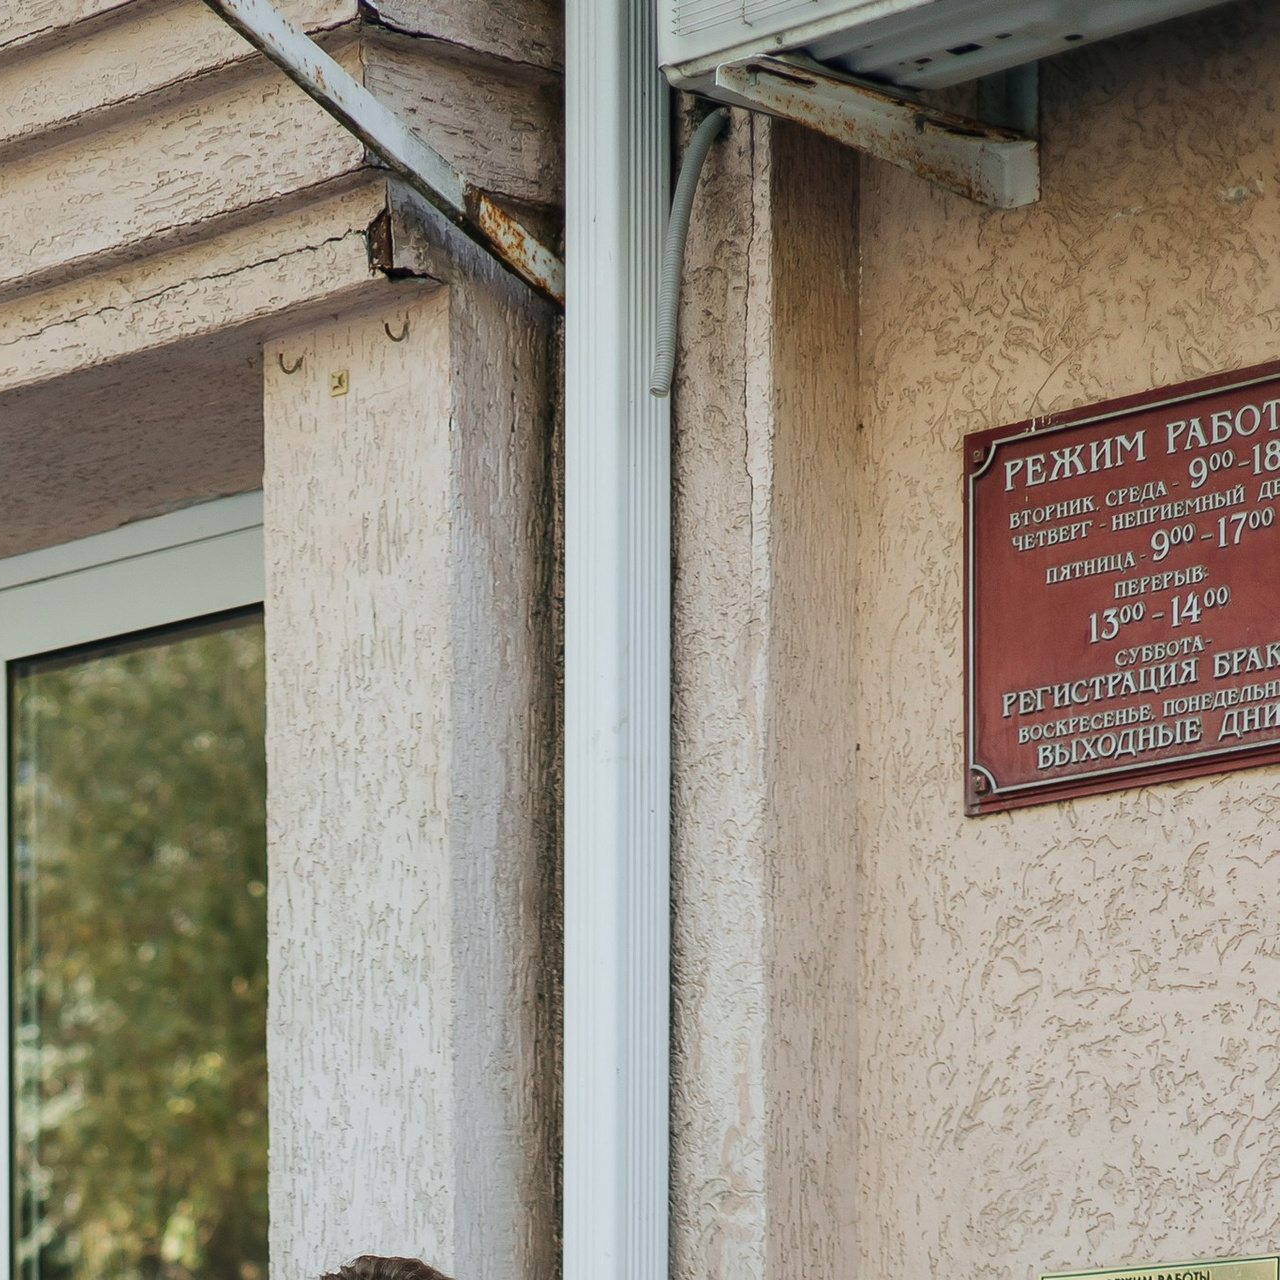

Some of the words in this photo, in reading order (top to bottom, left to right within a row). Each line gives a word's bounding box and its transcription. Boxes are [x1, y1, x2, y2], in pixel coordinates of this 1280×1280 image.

[1004, 430, 1147, 492] РЕЖИМ
[1012, 520, 1094, 551] ЧЕТВЕРГ
[1111, 484, 1247, 531] НЕПРИЕМНЫЙ
[1105, 481, 1168, 508] СРЕДА
[1045, 551, 1136, 585] ПЯТНИЦА
[1114, 565, 1209, 599] ПЕРЕРЫВ:
[1001, 657, 1200, 719] РЕГИСТРАЦИЯ
[1162, 679, 1280, 717] ПОНЕДЕЛЬН
[1036, 717, 1203, 769] ВЫХОДНЫЕ
[1218, 703, 1280, 742] ДНИ
